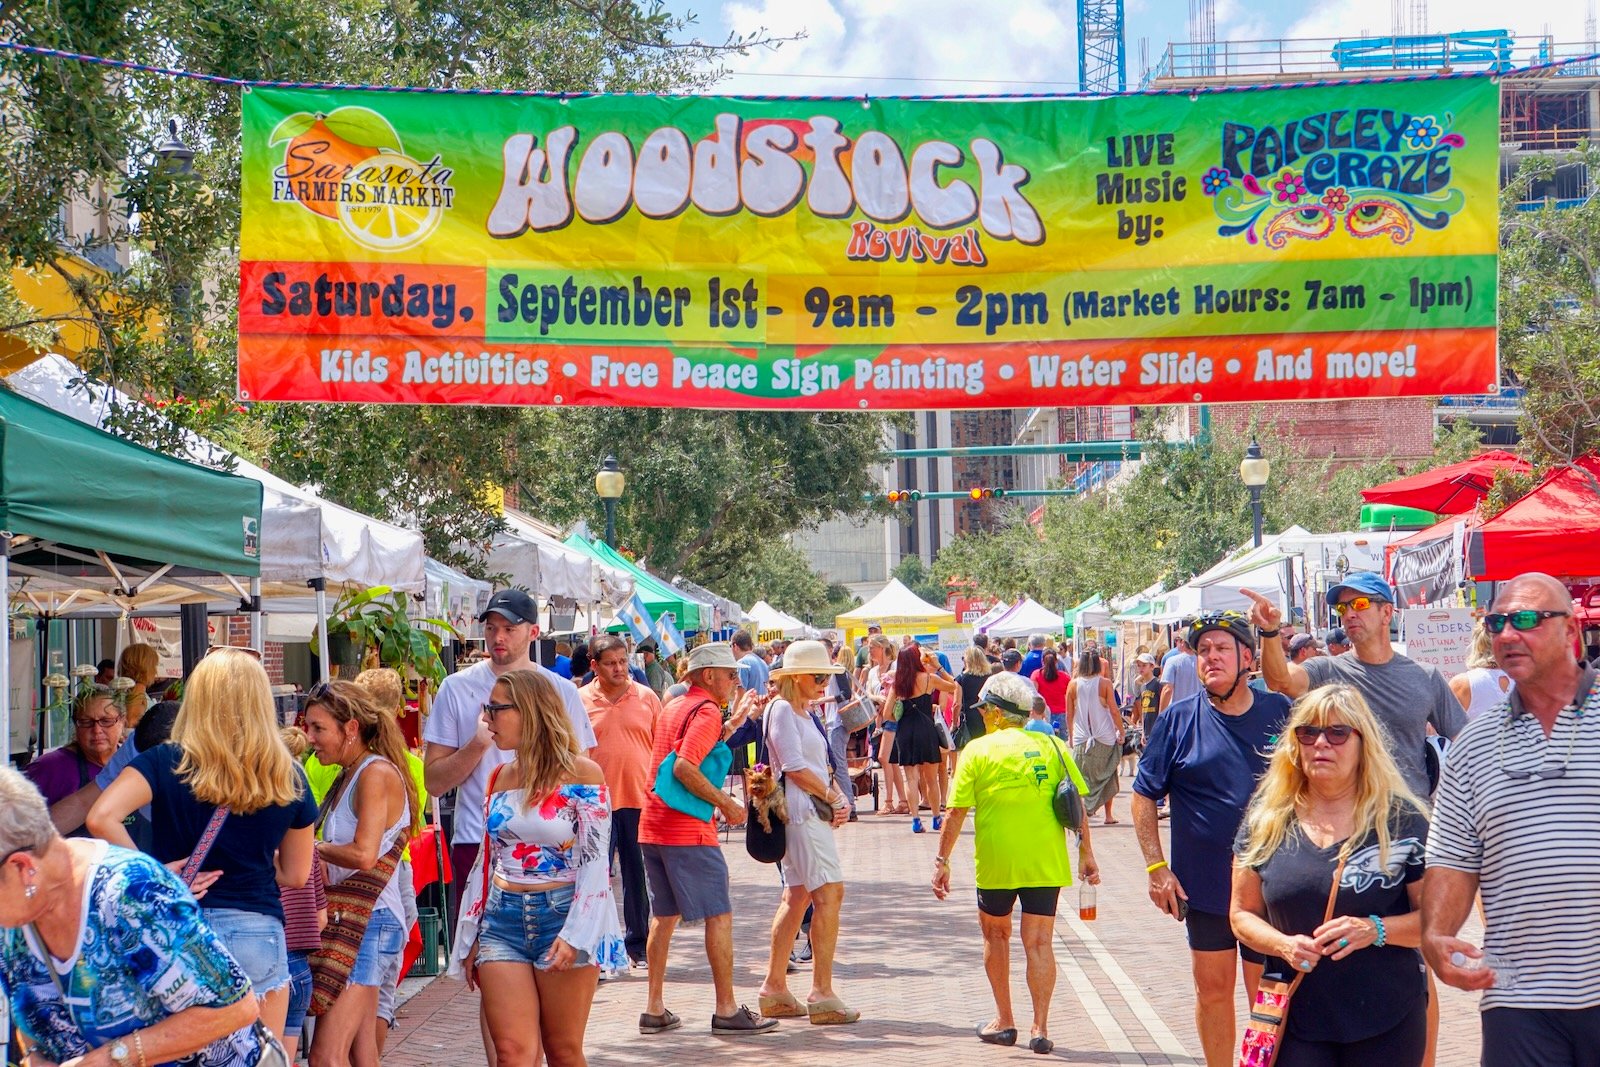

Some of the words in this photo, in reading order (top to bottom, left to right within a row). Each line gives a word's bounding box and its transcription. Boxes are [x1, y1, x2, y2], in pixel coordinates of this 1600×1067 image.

[274, 141, 452, 184] Sarasota
[1107, 133, 1175, 168] LIVE
[1222, 108, 1412, 179] PAISLEY
[486, 112, 1047, 246] Woodstock
[1096, 170, 1187, 206] Music
[1304, 143, 1452, 195] CRAZE
[273, 181, 366, 204] FARMERS
[373, 184, 453, 208] MARKET
[846, 219, 988, 267] Revival
[1118, 210, 1164, 246] by:
[262, 272, 474, 328] Saturday,
[498, 273, 691, 335] September
[804, 287, 895, 328] 9am
[956, 285, 1048, 335] 2pm
[1062, 285, 1180, 326] (Market
[1194, 285, 1290, 315] Hours:
[1305, 280, 1366, 310] 7am
[1409, 275, 1473, 314] 1pm)
[320, 349, 389, 383] Kids
[402, 350, 549, 386] Activities
[591, 355, 659, 387] Free
[672, 357, 758, 390] Peace
[771, 357, 840, 396] Sign
[854, 356, 984, 396] Painting
[1028, 353, 1127, 389] Water
[1140, 351, 1214, 386] Slide
[1254, 347, 1312, 383] And
[1326, 344, 1416, 380] more!
[758, 630, 782, 642] FOOD
